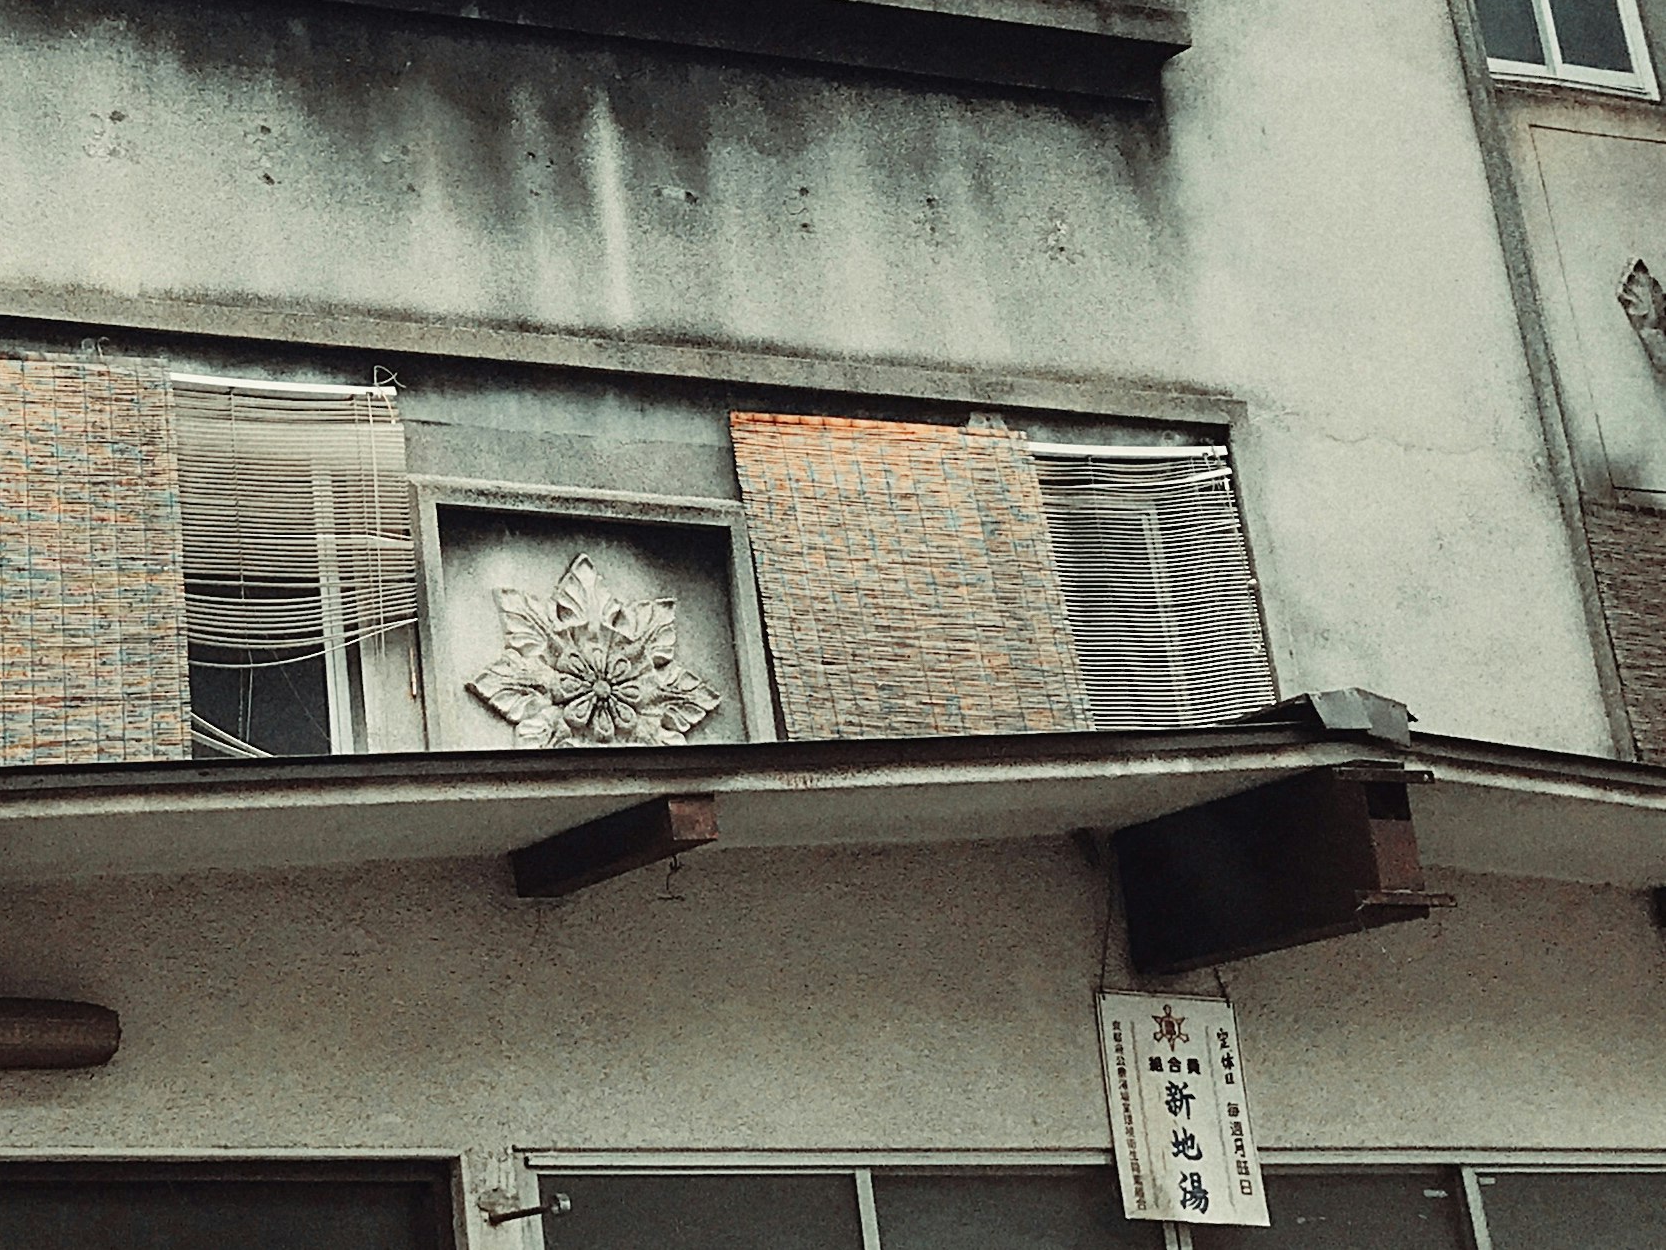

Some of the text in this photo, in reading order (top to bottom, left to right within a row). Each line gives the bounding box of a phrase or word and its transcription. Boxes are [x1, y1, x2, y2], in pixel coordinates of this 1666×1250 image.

[1216, 1028, 1235, 1085] 定休日
[1165, 1081, 1209, 1214] 新地湯
